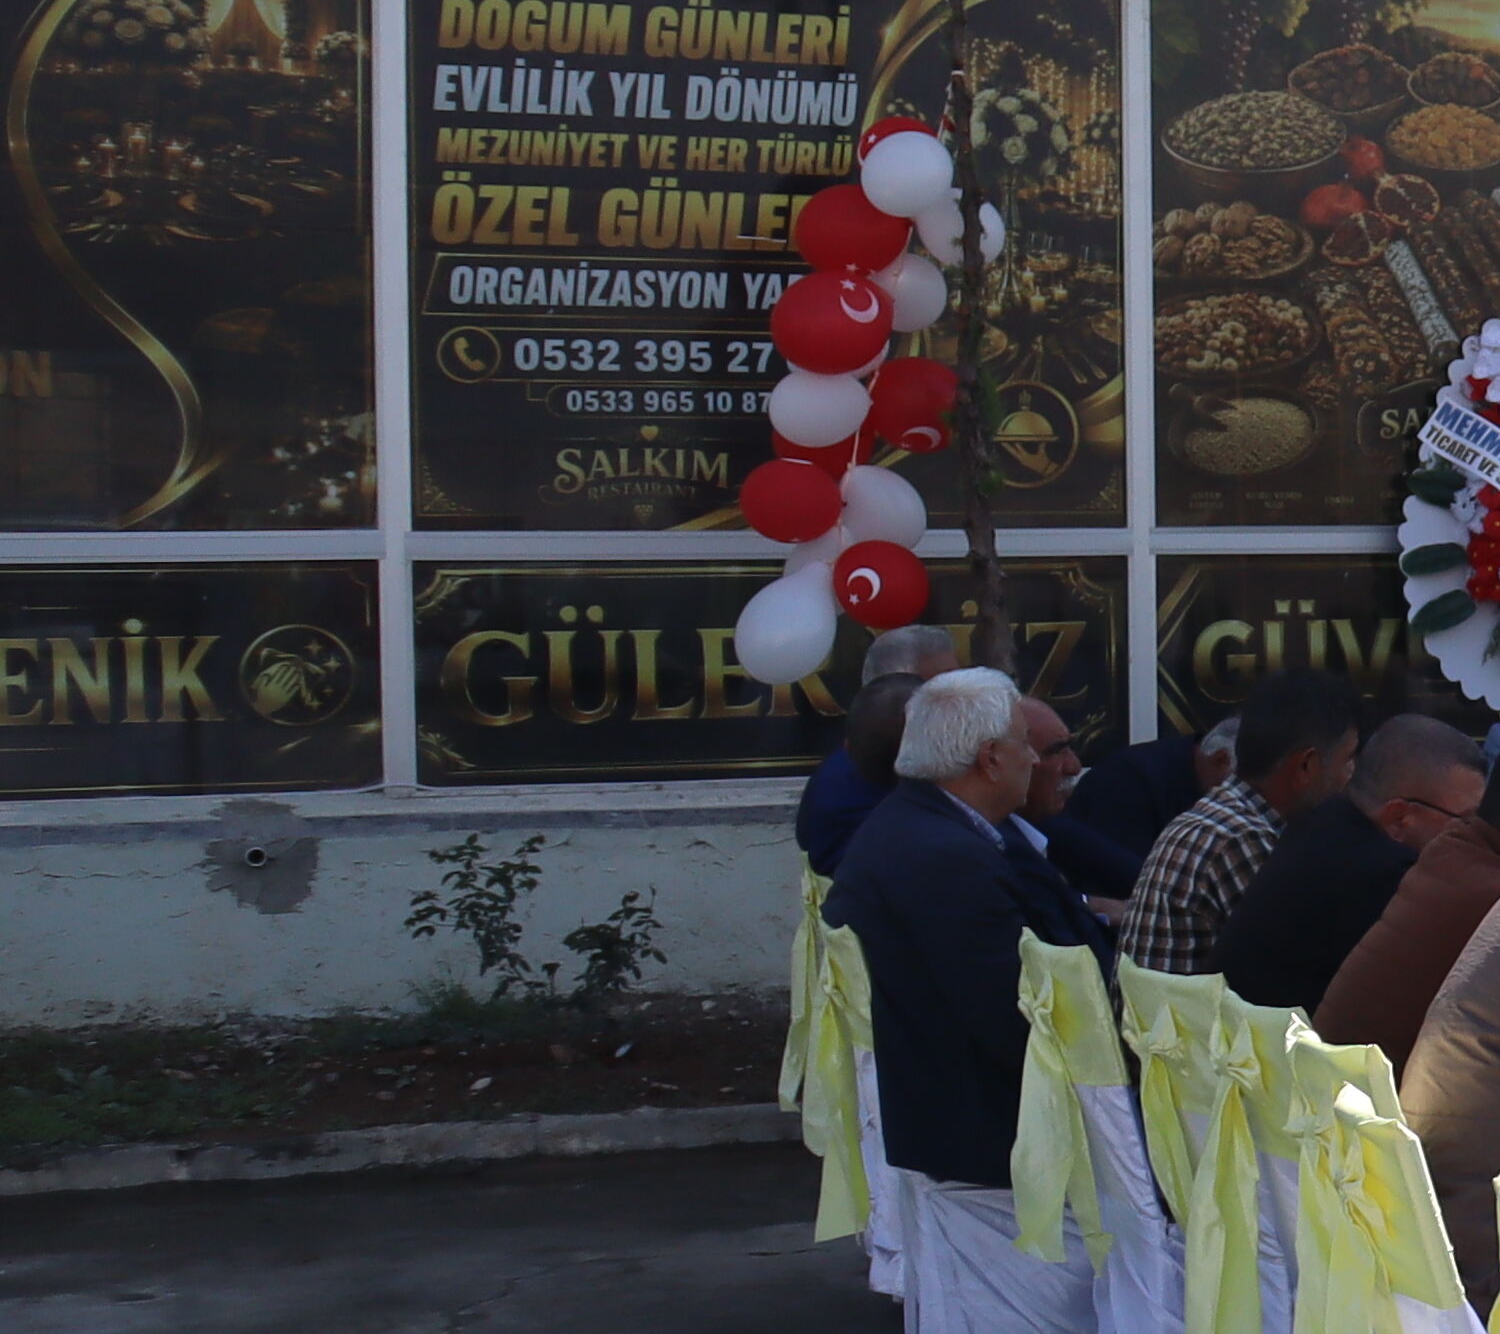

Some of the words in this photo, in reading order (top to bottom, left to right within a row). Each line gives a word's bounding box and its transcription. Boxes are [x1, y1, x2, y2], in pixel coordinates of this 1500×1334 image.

[433, 55, 593, 119] EVLİLİK
[609, 69, 671, 122] YIL
[686, 67, 858, 128] DÖNÜMÜ
[436, 123, 629, 168] MEZUNİYET
[637, 135, 677, 172] VE
[686, 135, 749, 174] HER
[756, 133, 853, 178] TÜRLÜ
[431, 171, 579, 248] ÖZEL
[448, 260, 728, 311] ORGANİZASYON
[513, 338, 620, 374] 0532
[632, 341, 712, 374] 395
[726, 341, 773, 373] 27
[566, 390, 636, 415] 0533
[643, 390, 696, 415] 965
[704, 390, 732, 414] 10
[738, 390, 772, 414] 87
[554, 447, 729, 494] SALKIM
[1426, 426, 1481, 473] TİCARET
[1477, 459, 1499, 483] VE
